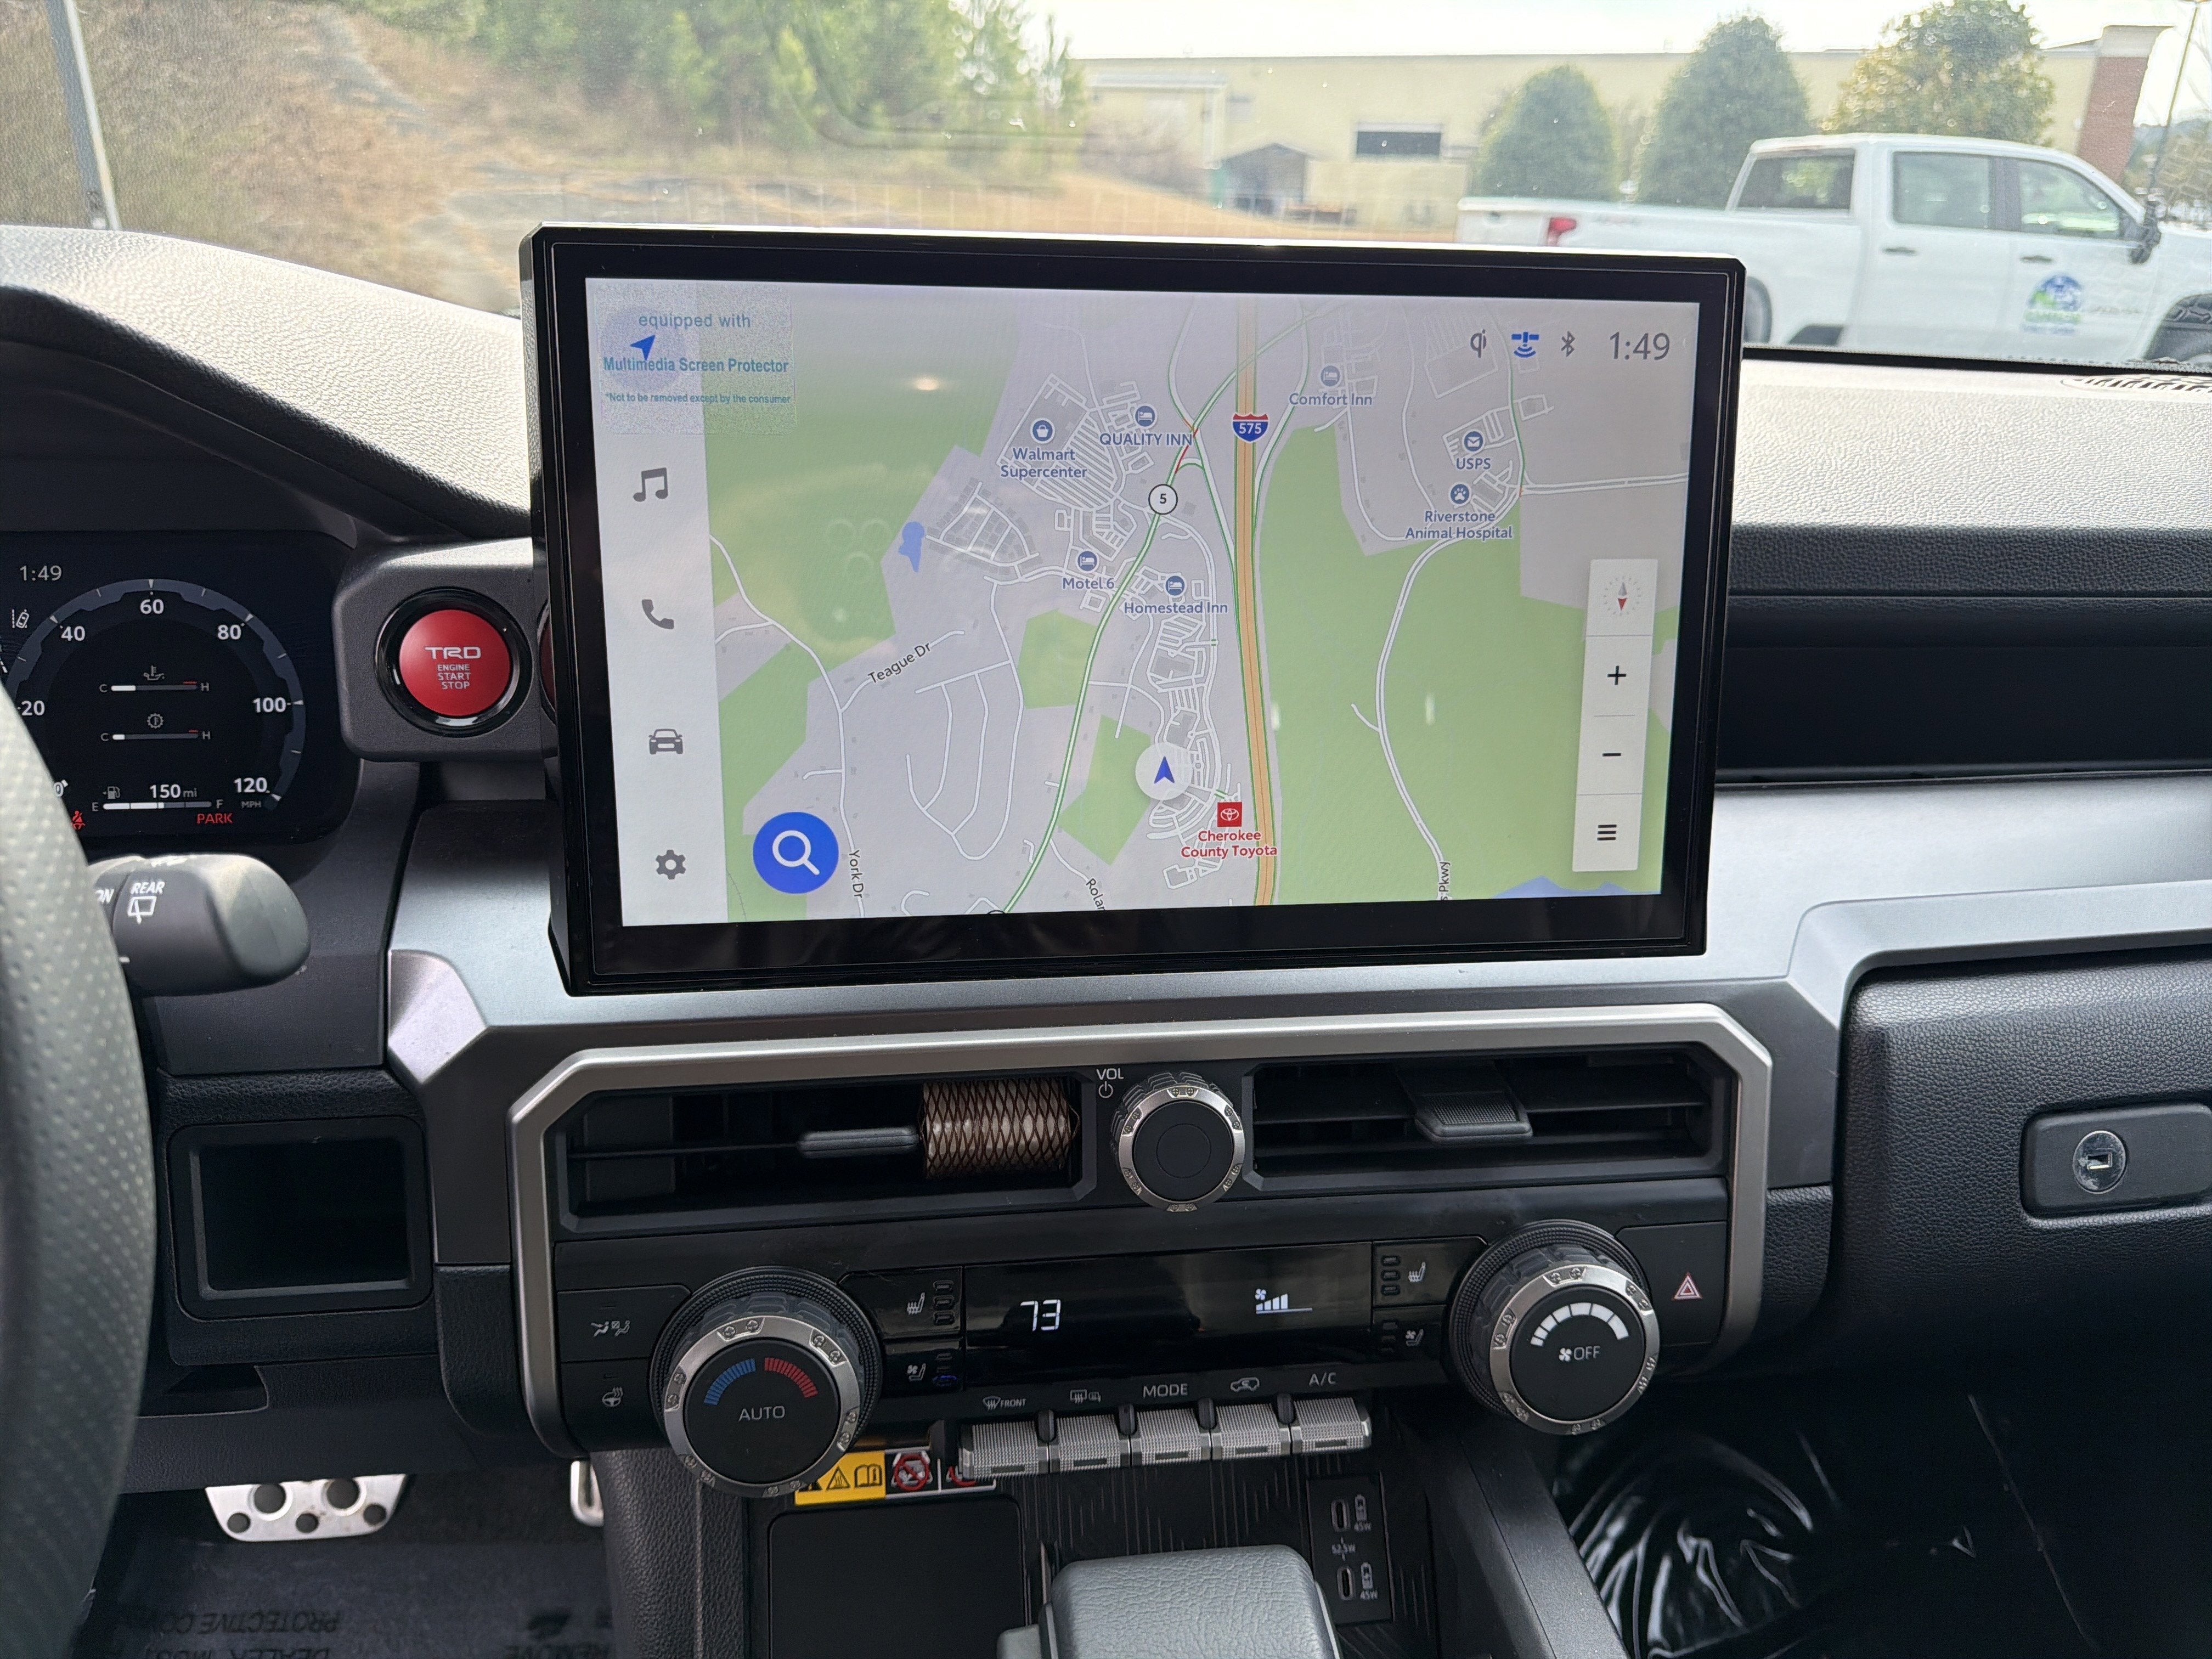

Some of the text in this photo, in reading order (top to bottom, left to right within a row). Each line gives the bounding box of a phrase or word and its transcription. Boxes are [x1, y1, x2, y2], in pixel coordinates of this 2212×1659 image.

[639, 314, 751, 330] equipped with
[1609, 331, 1671, 360] 1:49
[603, 357, 789, 373] Multimedia Screen Protector
[626, 393, 636, 402] to
[637, 393, 648, 402] be
[651, 393, 687, 403] removed
[690, 394, 718, 404] except
[720, 394, 731, 404] by
[732, 394, 747, 403] the
[749, 395, 791, 404] consumer
[1289, 392, 1373, 406] Comfort Inn
[1239, 422, 1262, 435] 575
[1099, 432, 1193, 447] QUALITY INN
[1013, 447, 1075, 461] Walmart
[1456, 458, 1491, 471] USPS
[1001, 465, 1088, 481] Supercenter
[1159, 493, 1167, 505] 5
[1425, 511, 1496, 523] Riverstone
[1406, 526, 1513, 540] Animal Hospital
[20, 565, 63, 582] 1:49
[1063, 577, 1115, 590] Motel 6
[140, 599, 164, 614] 60
[1124, 601, 1228, 615] Homestead Inn
[61, 626, 86, 641] 40
[217, 625, 241, 640] 80
[425, 646, 481, 659] TRD
[868, 641, 932, 684] Teague Dr
[437, 673, 471, 681] START
[99, 684, 108, 693] C
[201, 682, 210, 692] H
[442, 681, 470, 690] STOP
[22, 700, 45, 716] 20
[253, 697, 286, 713] 100
[100, 733, 109, 742] C
[202, 731, 211, 740] H
[150, 784, 198, 799] 150 mi
[234, 777, 267, 793] 120
[92, 802, 99, 812] E
[216, 799, 223, 809] F
[241, 800, 262, 809] MPH
[196, 812, 233, 825] PARK
[1198, 830, 1261, 842] Cherokee
[1181, 844, 1277, 859] County Toyota
[848, 849, 864, 899] York Dr
[1438, 861, 1451, 892] Pkwy
[131, 881, 165, 894] REAR
[1096, 1068, 1124, 1080] VOL
[1020, 1299, 1062, 1332] 73
[1573, 1346, 1601, 1360] OFF
[1308, 1372, 1337, 1386] A/C
[1143, 1383, 1188, 1398] MODE
[1000, 1398, 1026, 1408] FRONT
[738, 1405, 786, 1421] AUTO
